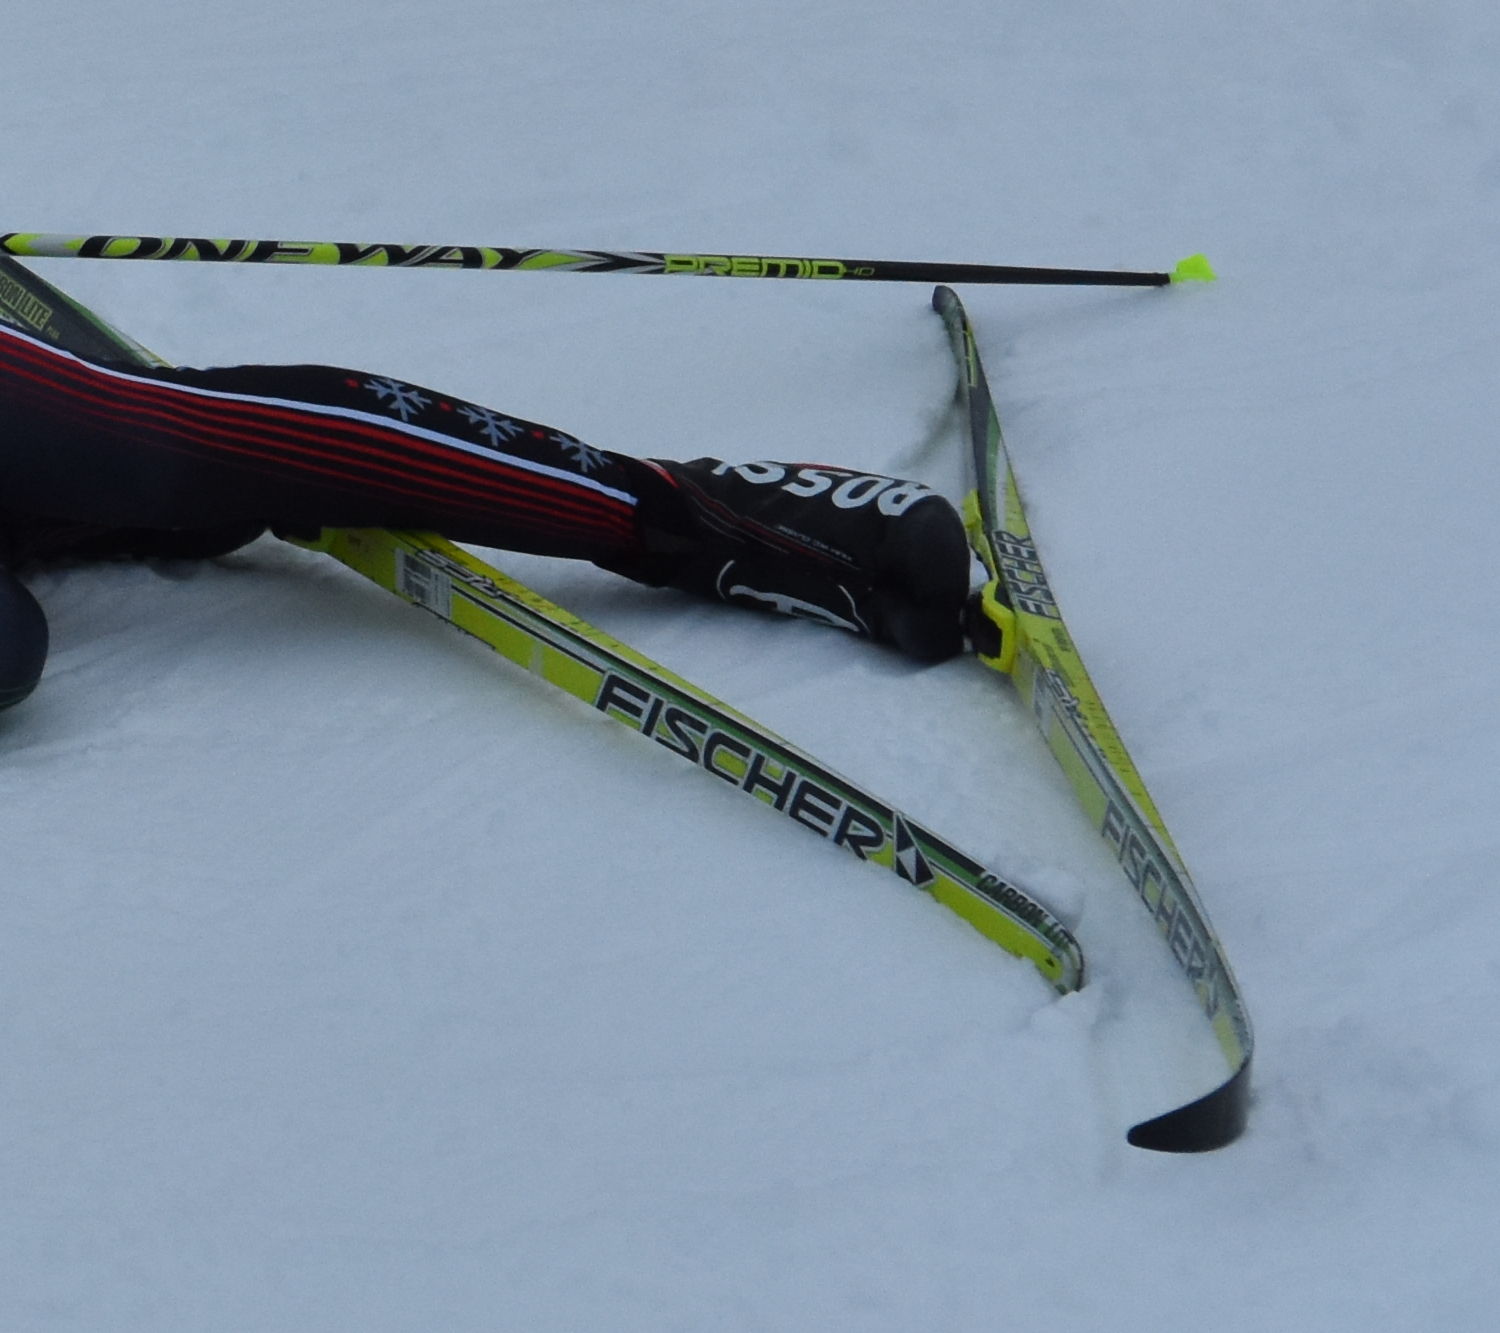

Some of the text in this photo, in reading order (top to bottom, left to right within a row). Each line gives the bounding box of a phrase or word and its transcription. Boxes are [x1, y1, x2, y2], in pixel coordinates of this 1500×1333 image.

[663, 253, 848, 280] PREMIO
[595, 671, 887, 862] FISCHER
[1101, 797, 1206, 980] FISCHER
